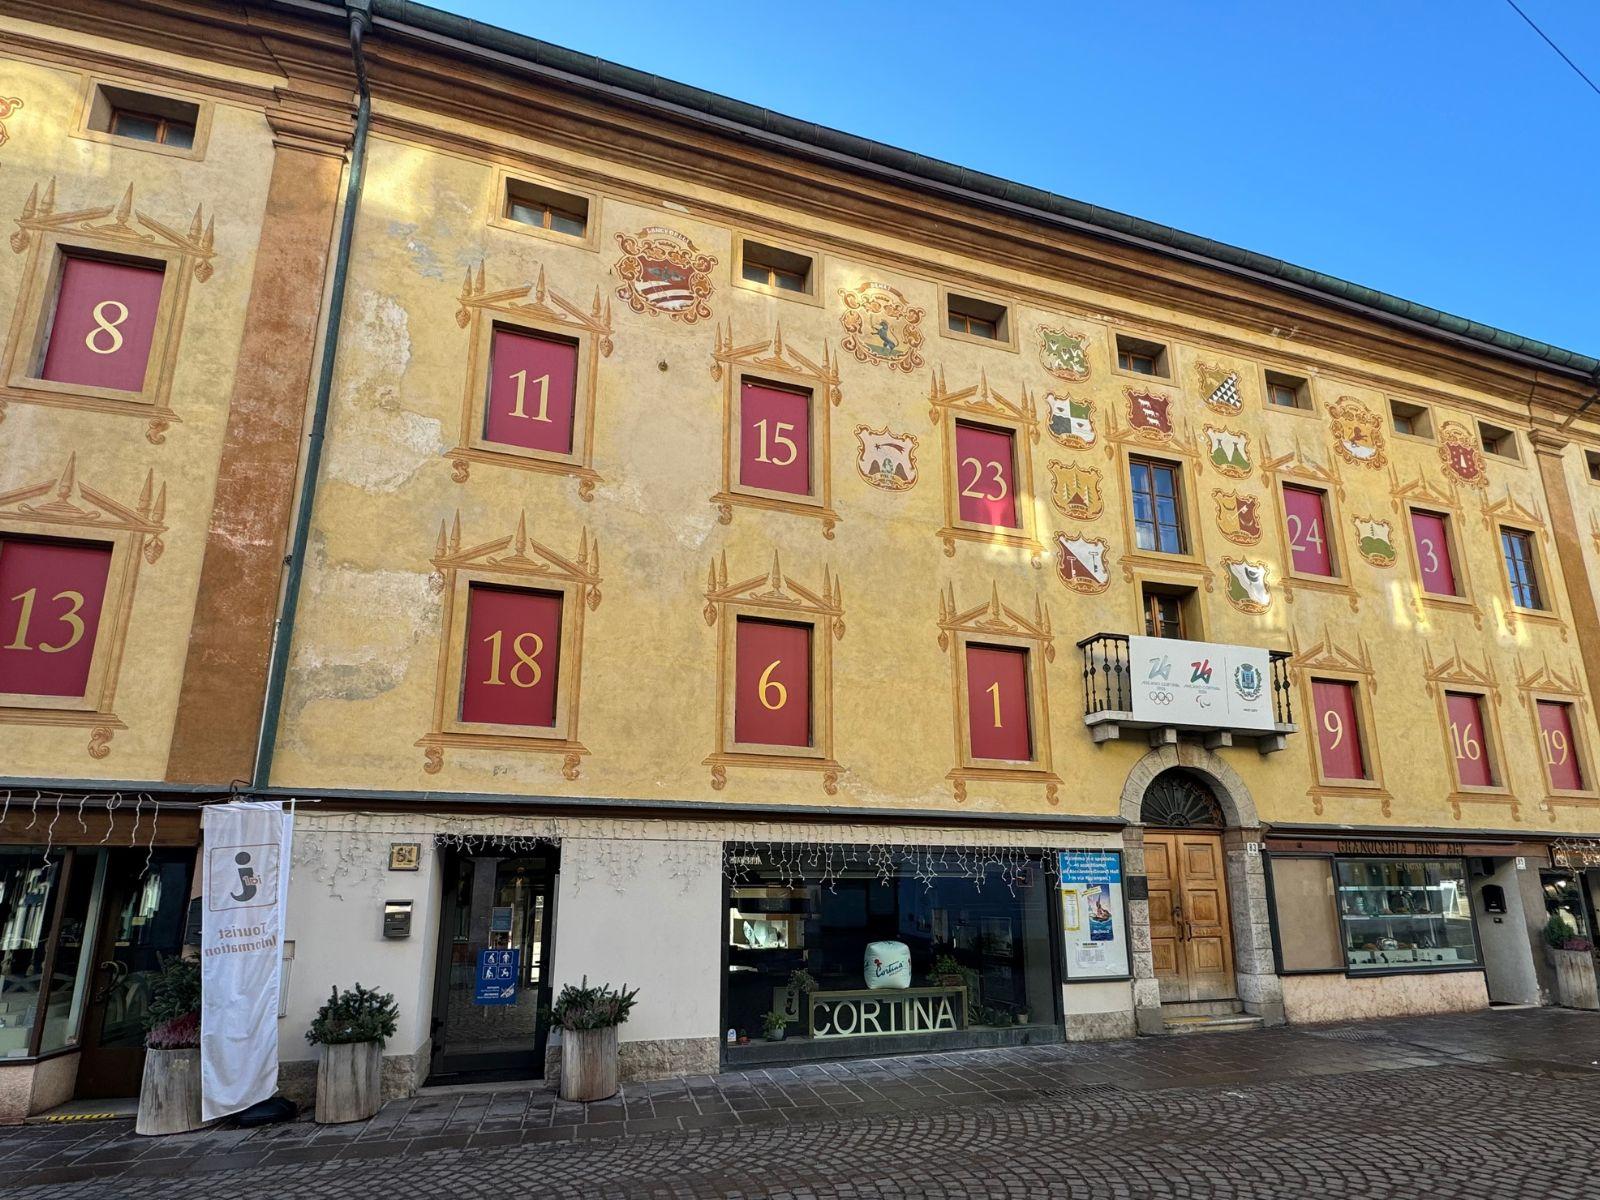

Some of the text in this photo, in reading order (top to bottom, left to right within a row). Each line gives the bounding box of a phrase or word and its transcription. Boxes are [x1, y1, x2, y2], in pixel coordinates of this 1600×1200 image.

[86, 301, 129, 354] 8
[509, 370, 553, 423] 11
[753, 418, 798, 466] 15
[961, 458, 1008, 501] 23
[1286, 514, 1323, 555] 24
[1421, 539, 1439, 573] 3
[5, 588, 85, 653] 13
[484, 631, 544, 688] 18
[758, 660, 788, 710] 6
[986, 682, 1003, 728] 1
[1323, 710, 1343, 750] 9
[1449, 722, 1481, 761] 16
[1541, 729, 1568, 766] 19
[875, 960, 904, 978] Cortina
[813, 995, 958, 1037] CORTINA
